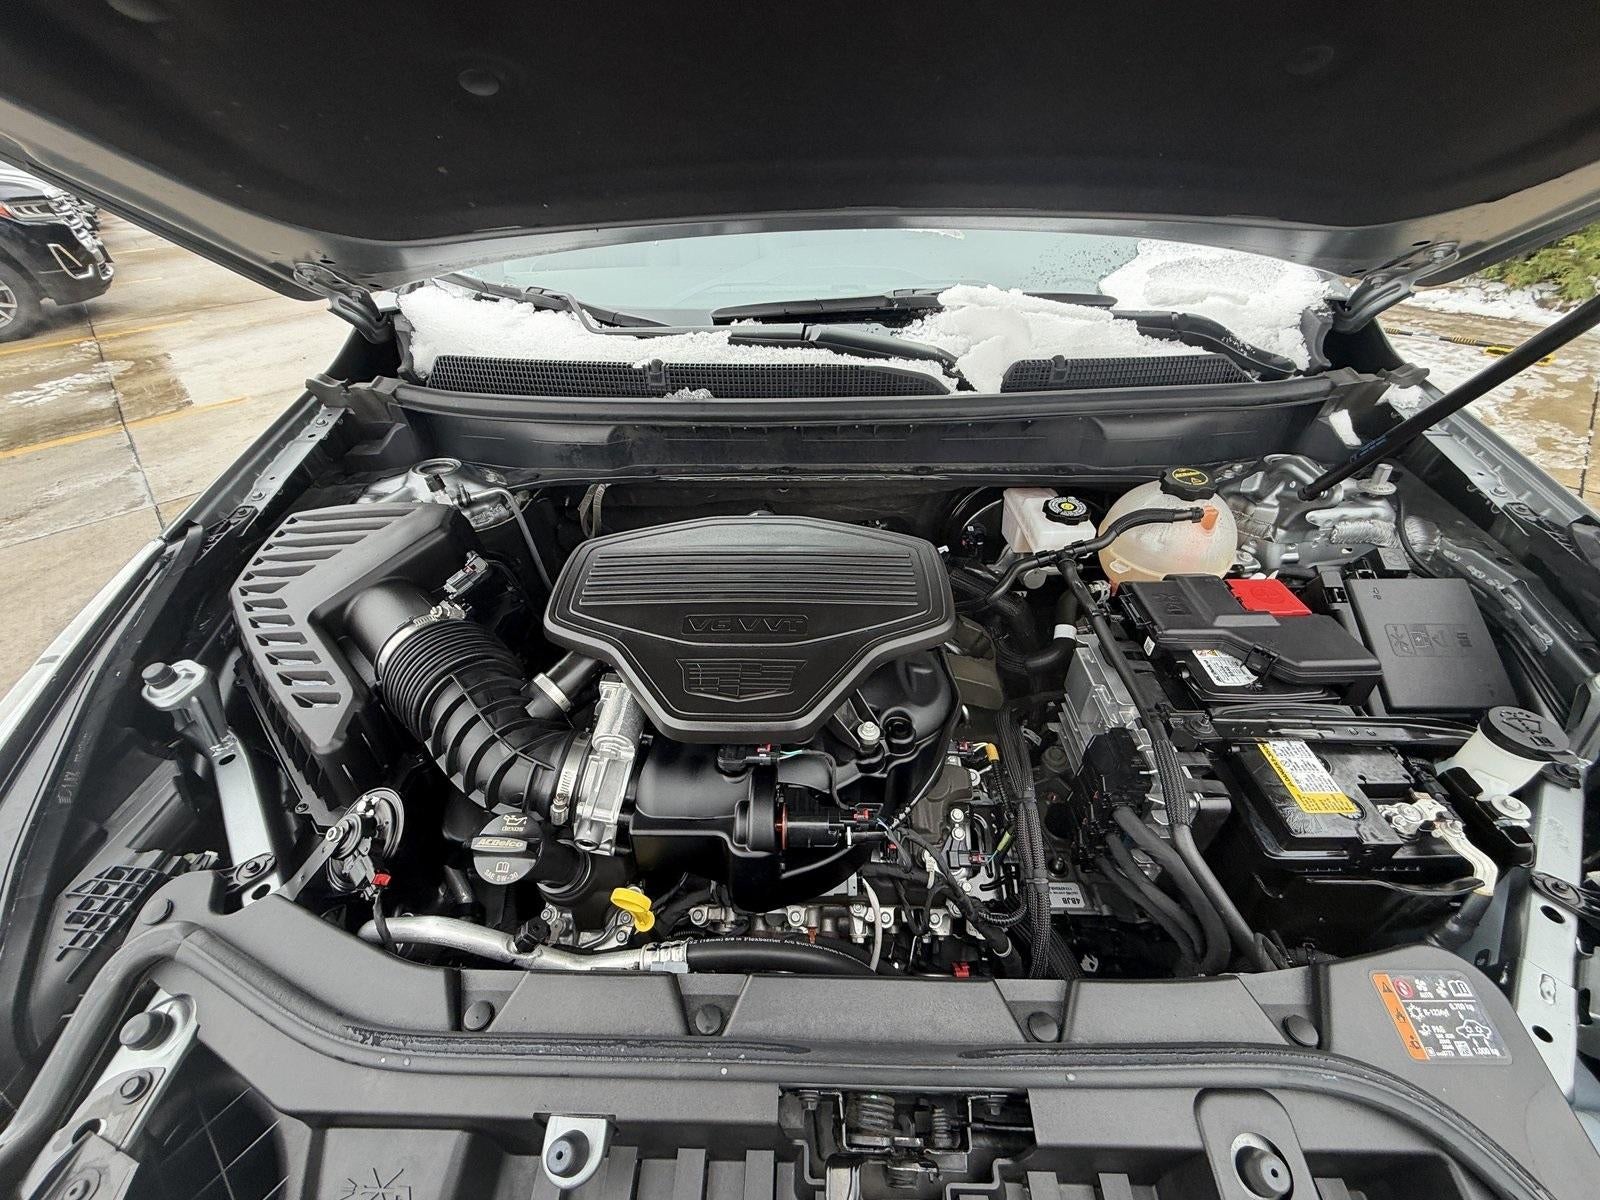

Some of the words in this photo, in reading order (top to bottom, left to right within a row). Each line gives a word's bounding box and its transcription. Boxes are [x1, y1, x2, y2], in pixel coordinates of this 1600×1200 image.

[687, 617, 732, 632] V6
[737, 617, 805, 632] VVT
[476, 838, 524, 848] ACDelco
